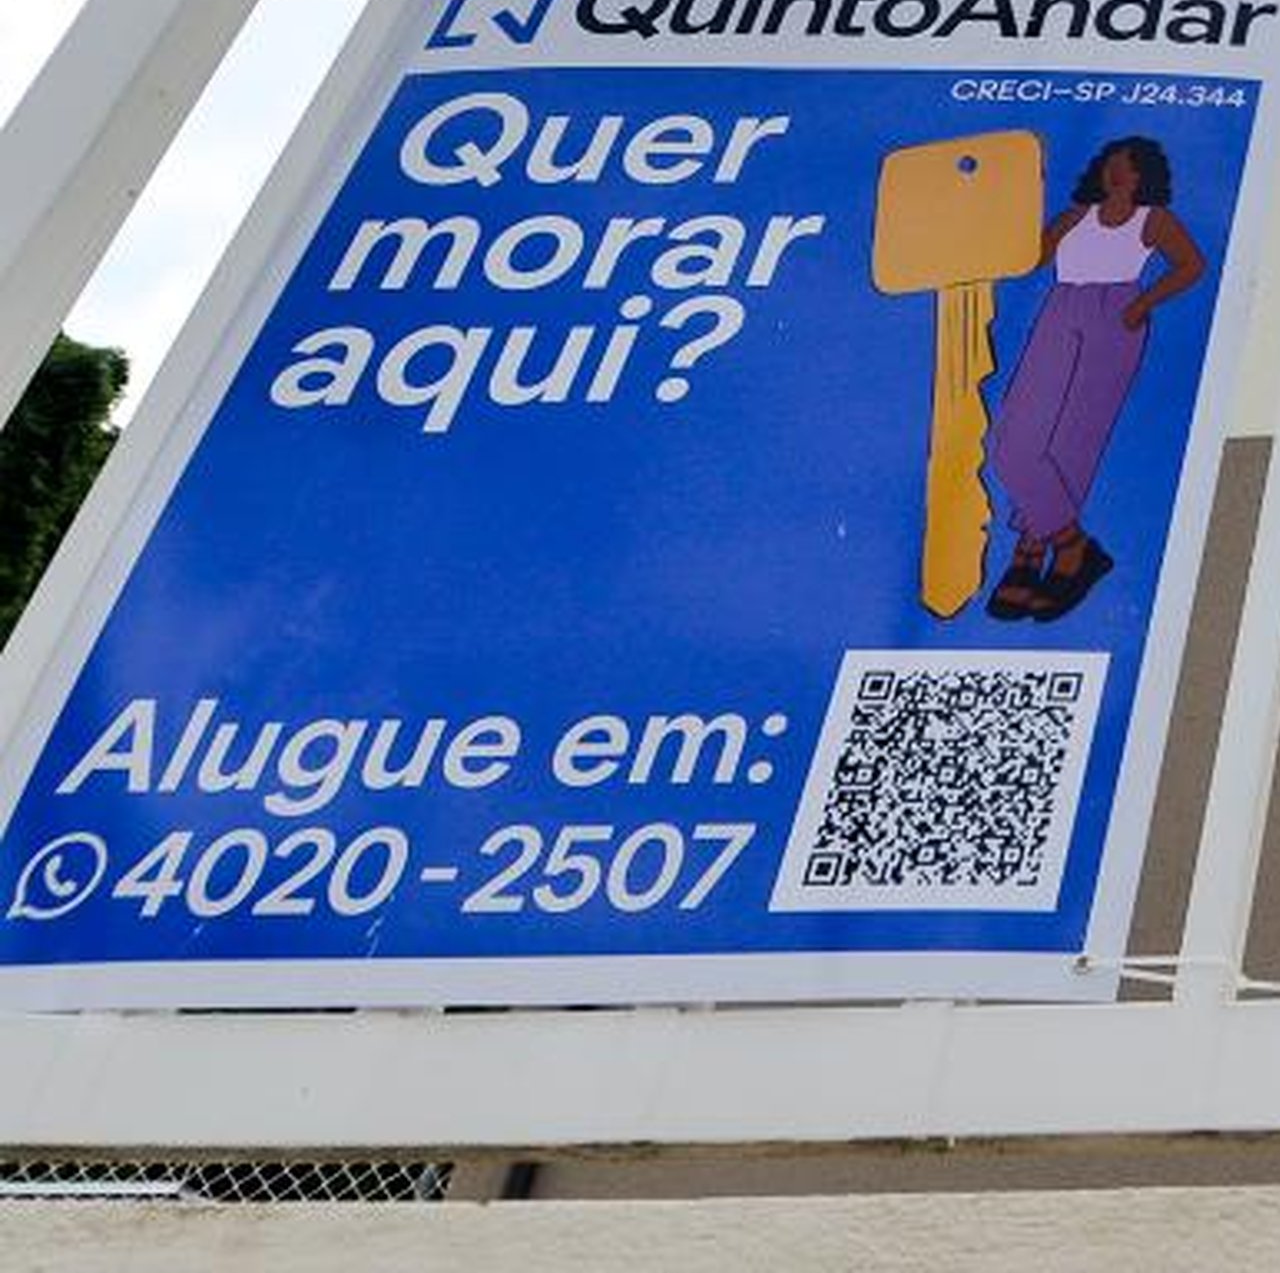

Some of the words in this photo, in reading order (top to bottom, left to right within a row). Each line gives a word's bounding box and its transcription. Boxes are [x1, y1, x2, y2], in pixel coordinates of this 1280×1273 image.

[399, 92, 788, 185] Quer
[951, 78, 1115, 105] CRECI-SP
[1121, 82, 1248, 109] J24.344
[326, 213, 822, 292] morar
[268, 295, 746, 432] aqui?
[56, 698, 522, 817] Alugue
[551, 712, 787, 785] em:
